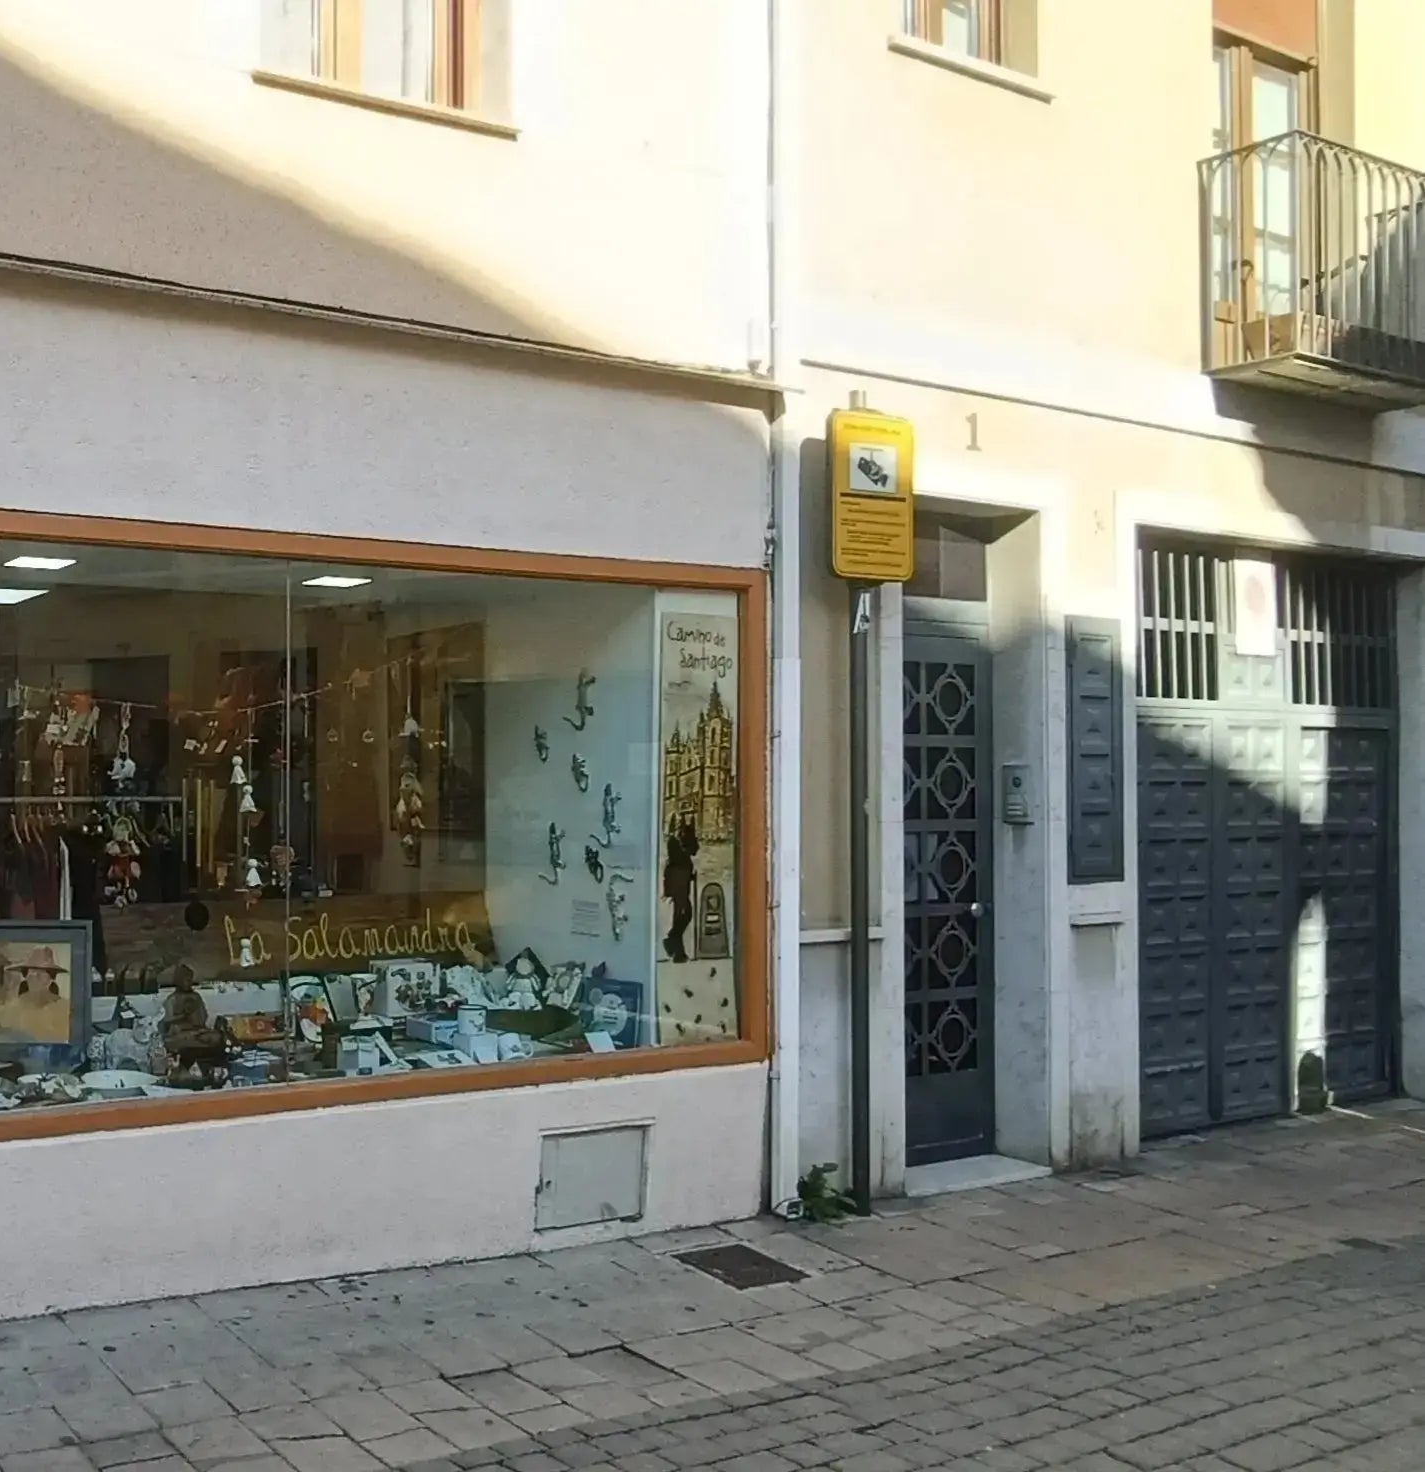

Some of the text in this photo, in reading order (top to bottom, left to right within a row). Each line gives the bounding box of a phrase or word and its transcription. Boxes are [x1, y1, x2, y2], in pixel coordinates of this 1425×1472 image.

[965, 412, 983, 452] 1
[667, 621, 726, 647] Camino de
[679, 646, 733, 678] Santiago
[224, 907, 475, 966] La Salamandra
